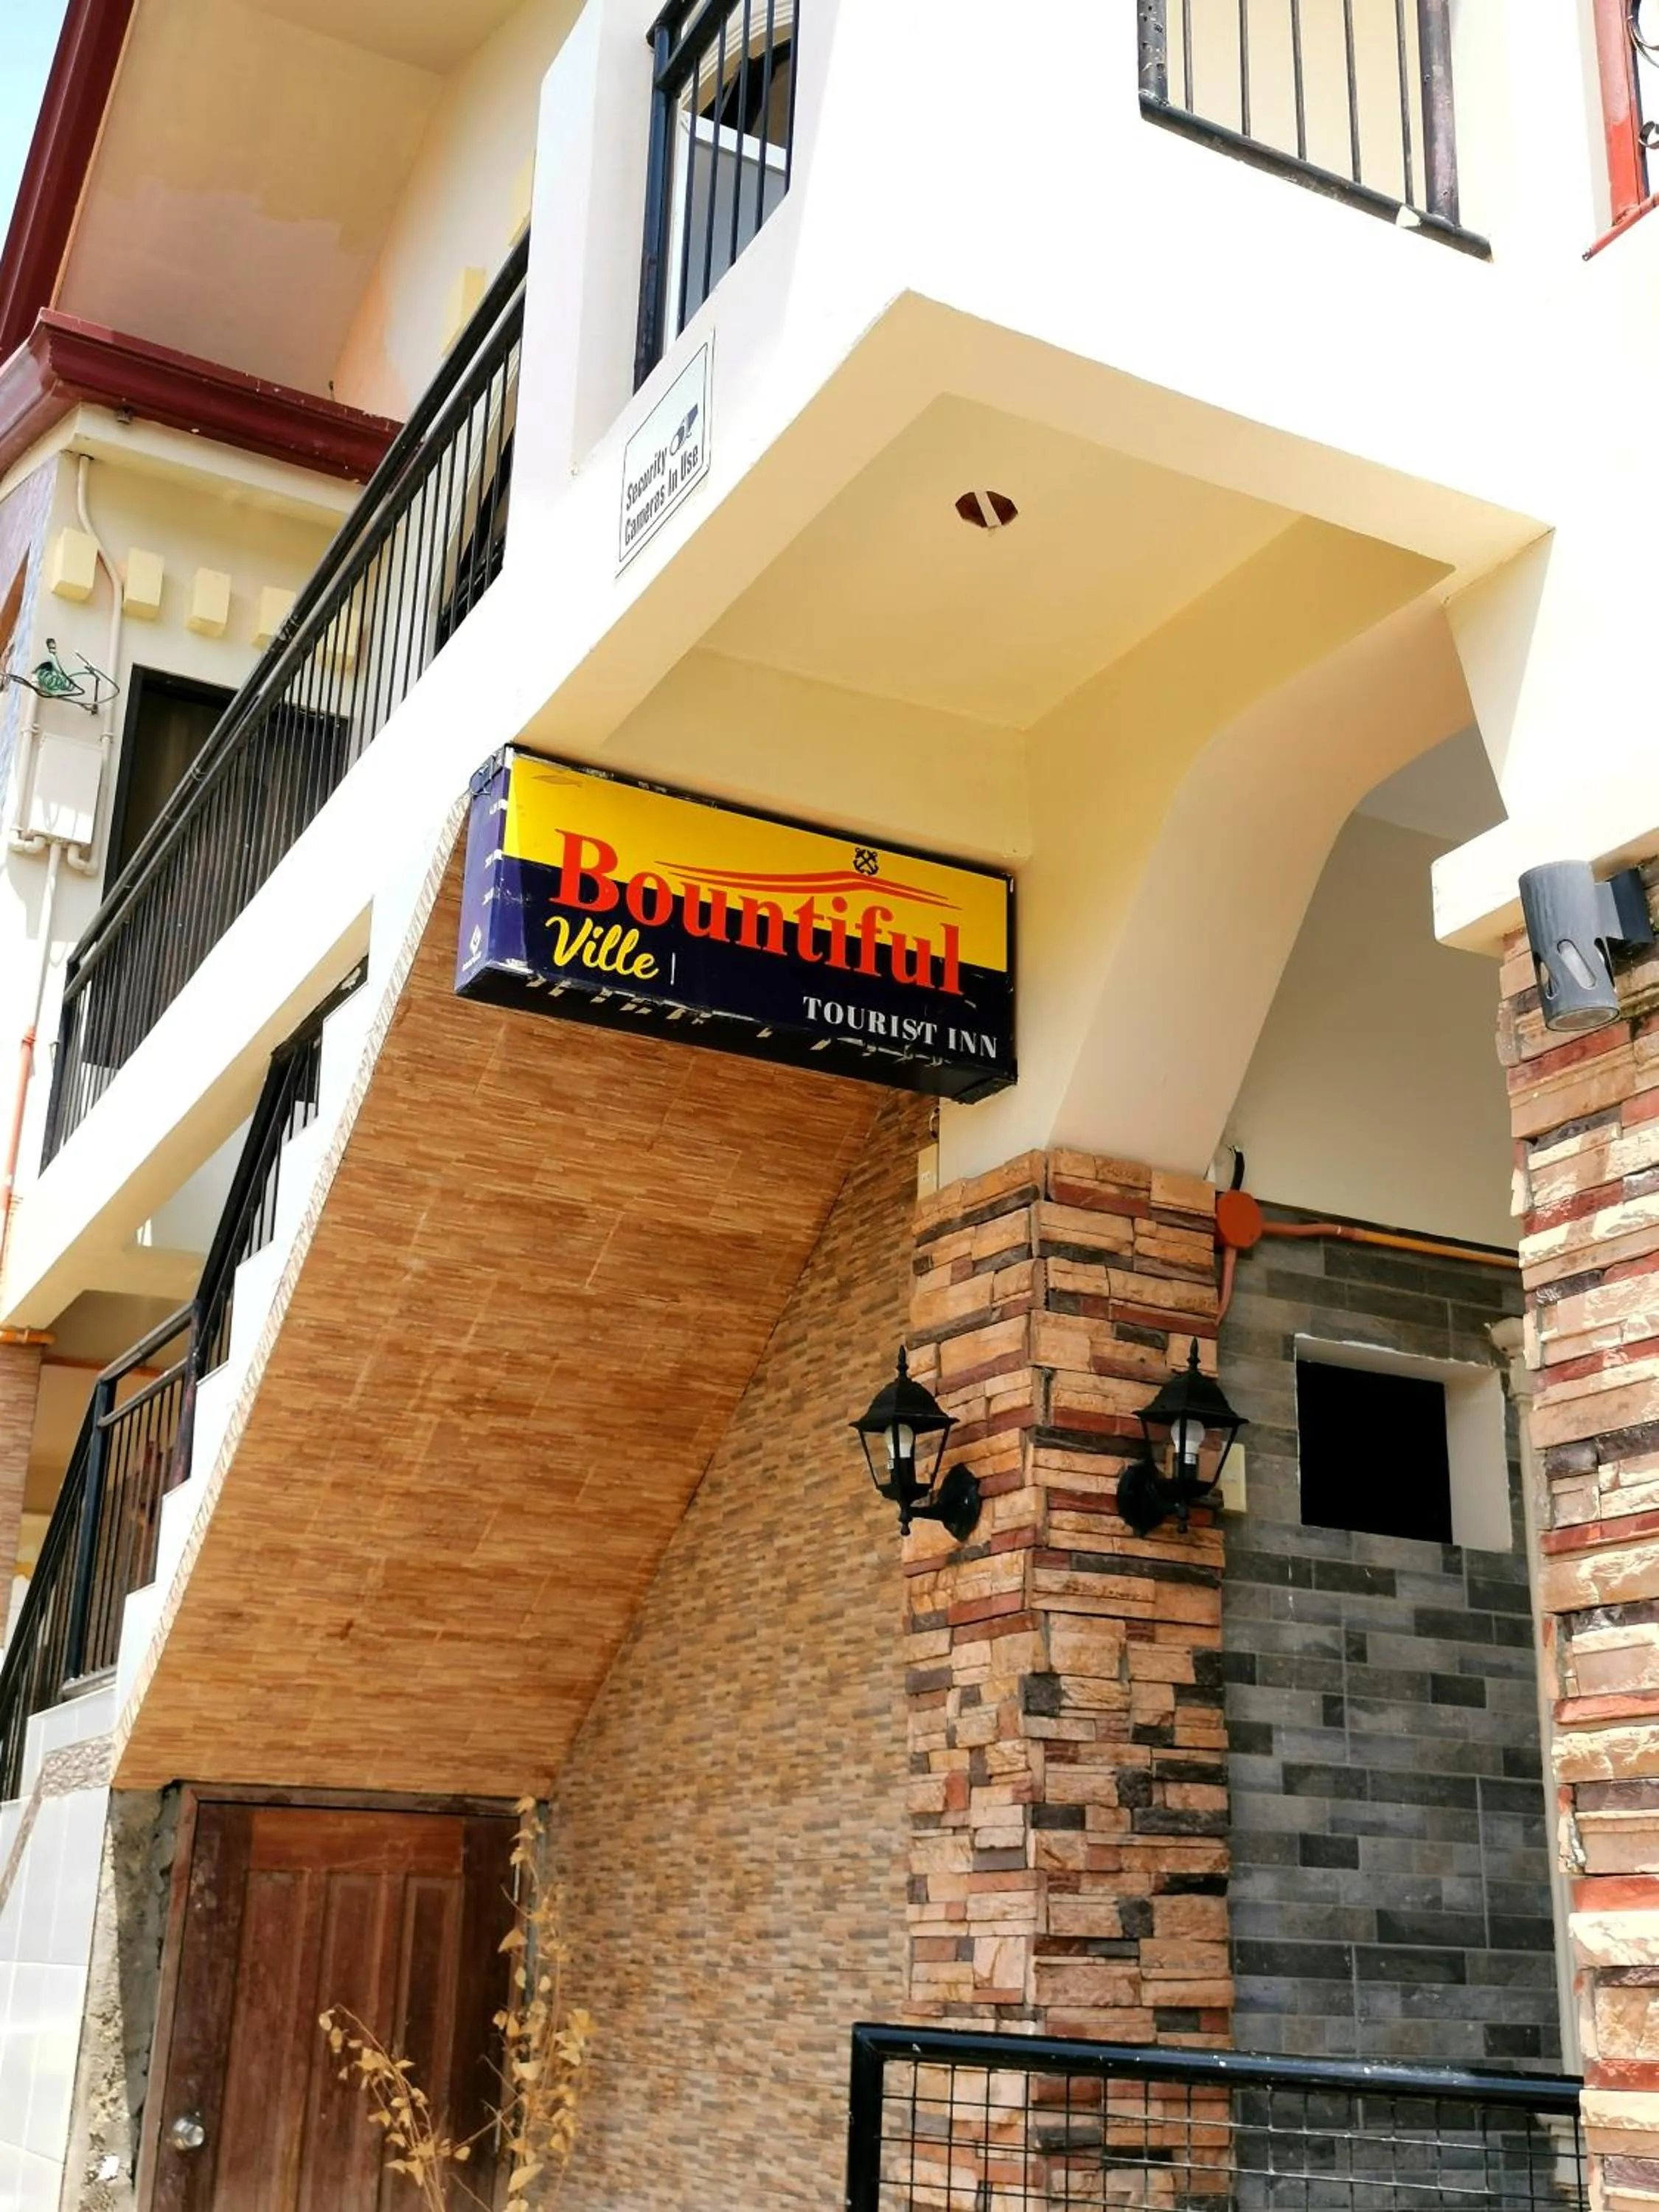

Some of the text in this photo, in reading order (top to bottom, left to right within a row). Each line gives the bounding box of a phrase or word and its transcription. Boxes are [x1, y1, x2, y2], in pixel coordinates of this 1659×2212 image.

[625, 445, 698, 546] Cameras In Use
[626, 447, 667, 511] Security
[554, 829, 964, 995] Bountiful
[545, 915, 659, 980] Ville
[802, 995, 998, 1060] TOURIST INN
